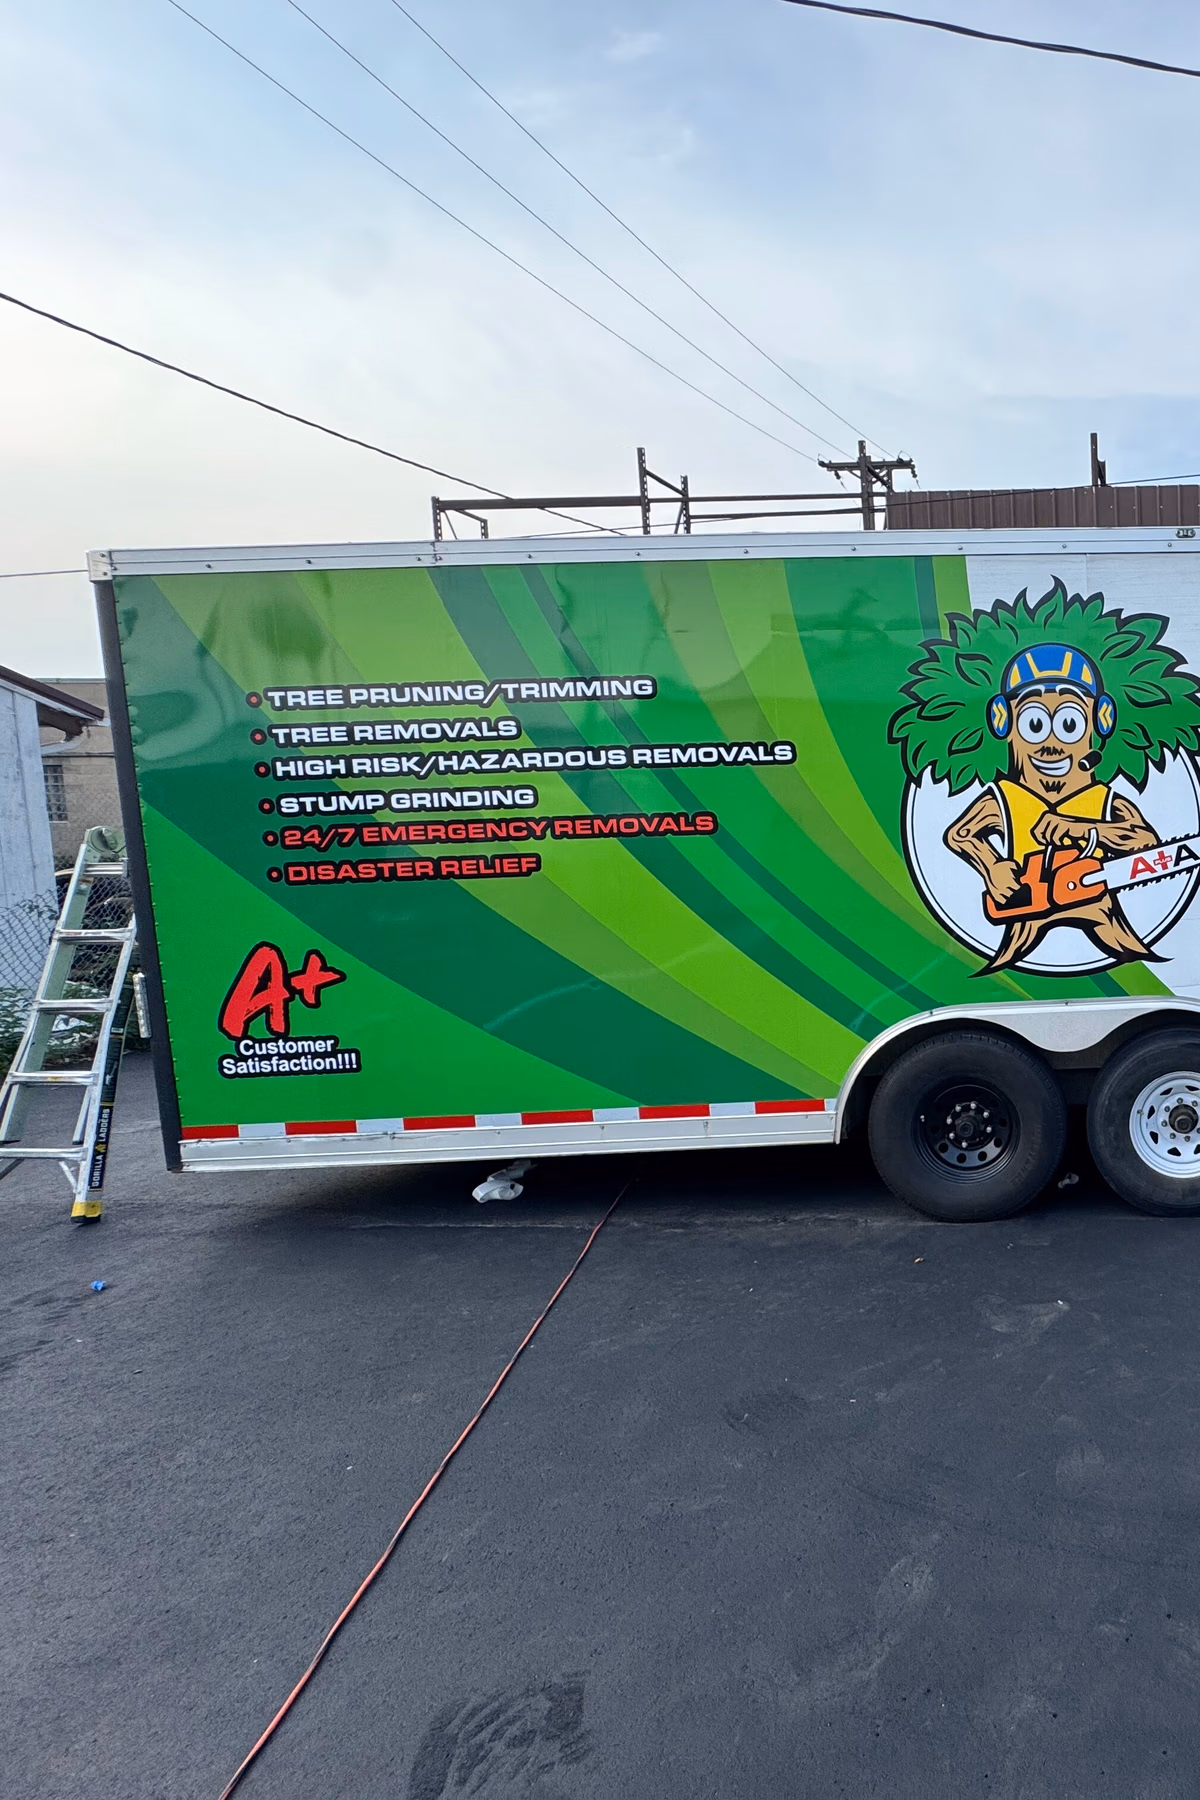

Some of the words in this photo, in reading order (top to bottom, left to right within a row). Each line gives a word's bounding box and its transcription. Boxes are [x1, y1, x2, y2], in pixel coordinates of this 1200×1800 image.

[267, 689, 345, 708] TREE
[349, 679, 654, 704] PRUNING/TRIMMING
[271, 726, 348, 745] TREE
[353, 720, 518, 742] REMOVALS
[275, 759, 347, 778] HIGH
[352, 750, 627, 776] RISK/HAZARDOUS
[632, 745, 794, 764] REMOVALS
[280, 793, 386, 814] STUMP
[390, 789, 535, 810] GRINDING
[284, 827, 355, 848] 24/7
[362, 820, 547, 843] EMERGENCY
[553, 815, 714, 836] REMOVALS
[287, 861, 434, 883] DISASTER
[440, 857, 537, 876] RELIEF
[221, 945, 342, 1039] A+
[239, 1038, 335, 1056] Customer
[222, 1052, 357, 1075] Satisfaction!!!
